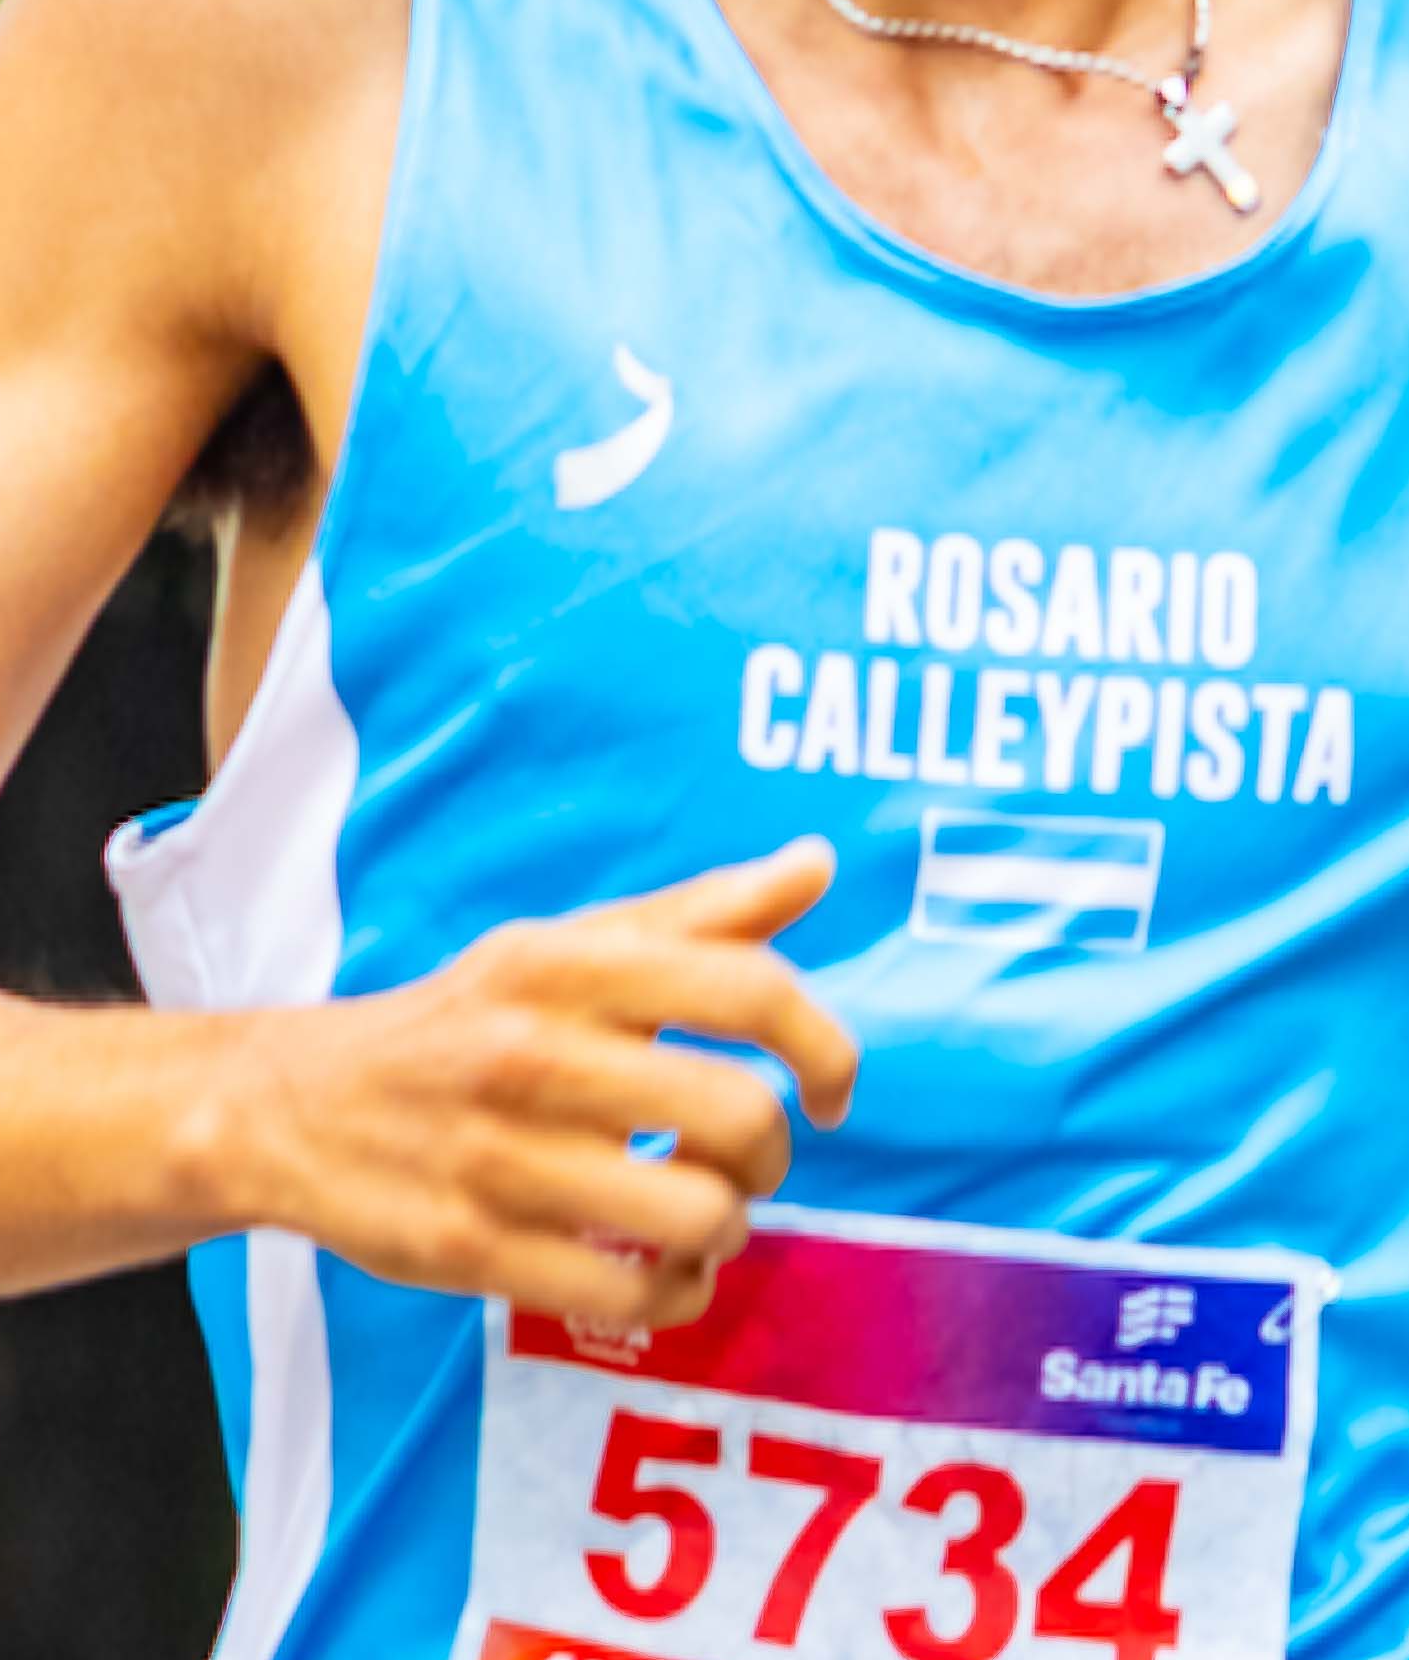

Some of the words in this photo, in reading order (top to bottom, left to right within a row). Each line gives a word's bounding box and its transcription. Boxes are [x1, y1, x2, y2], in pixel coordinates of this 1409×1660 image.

[861, 528, 1259, 671] ROSARIO
[737, 643, 1354, 807] CALLEYPISTA
[1041, 1350, 1189, 1410] Santa
[1194, 1362, 1252, 1417] Fe
